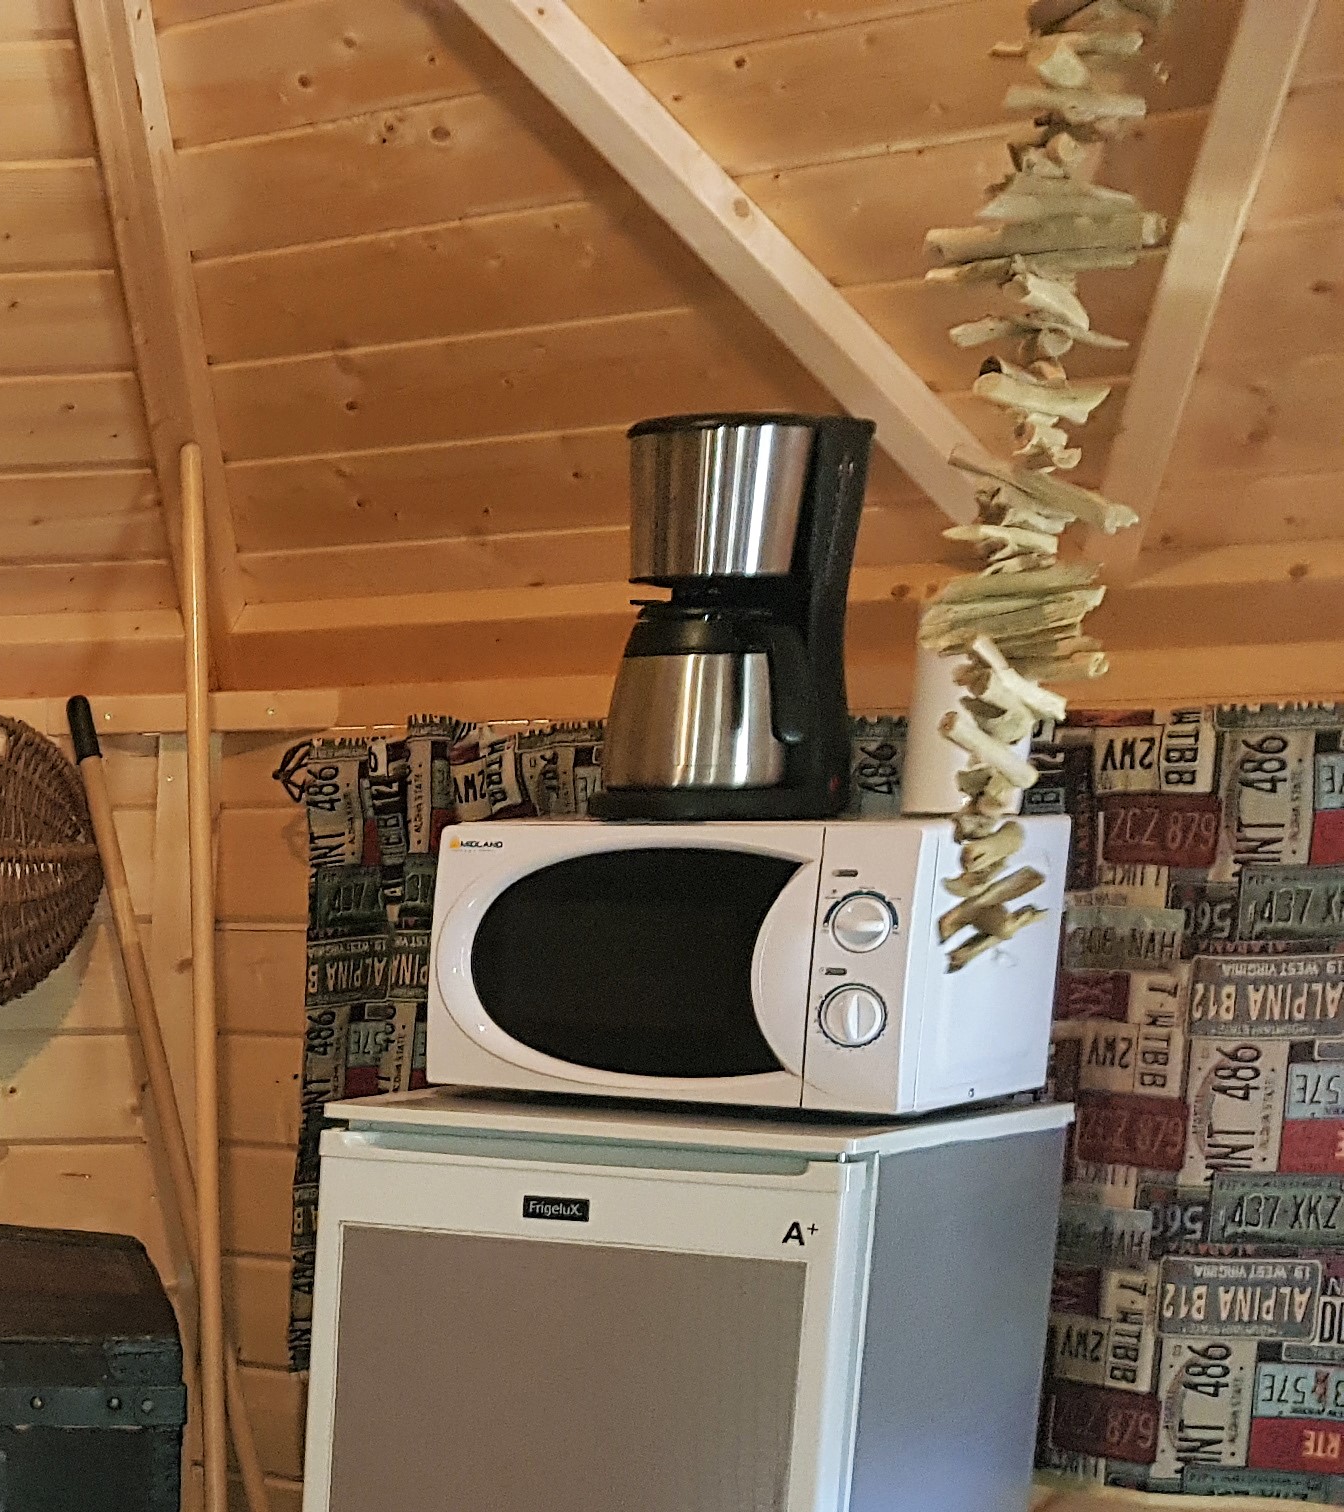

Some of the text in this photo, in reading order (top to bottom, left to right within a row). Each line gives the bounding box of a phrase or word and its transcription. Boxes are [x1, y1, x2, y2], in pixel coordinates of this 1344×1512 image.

[1238, 735, 1289, 794] 486
[325, 957, 387, 992] ALPINA
[1221, 963, 1278, 977] VIRGINIA
[1280, 962, 1319, 976] WEST
[1192, 981, 1344, 1021] ALPINA B12
[1211, 1043, 1262, 1101] 486
[1295, 1074, 1341, 1104] 57E
[1248, 1265, 1287, 1280] WEST
[1163, 1283, 1208, 1321] B12
[1218, 1286, 1312, 1322] ALPINA
[1181, 1344, 1232, 1398] 486
[1262, 1373, 1308, 1405] 57E
[1302, 1429, 1341, 1459] RTE
